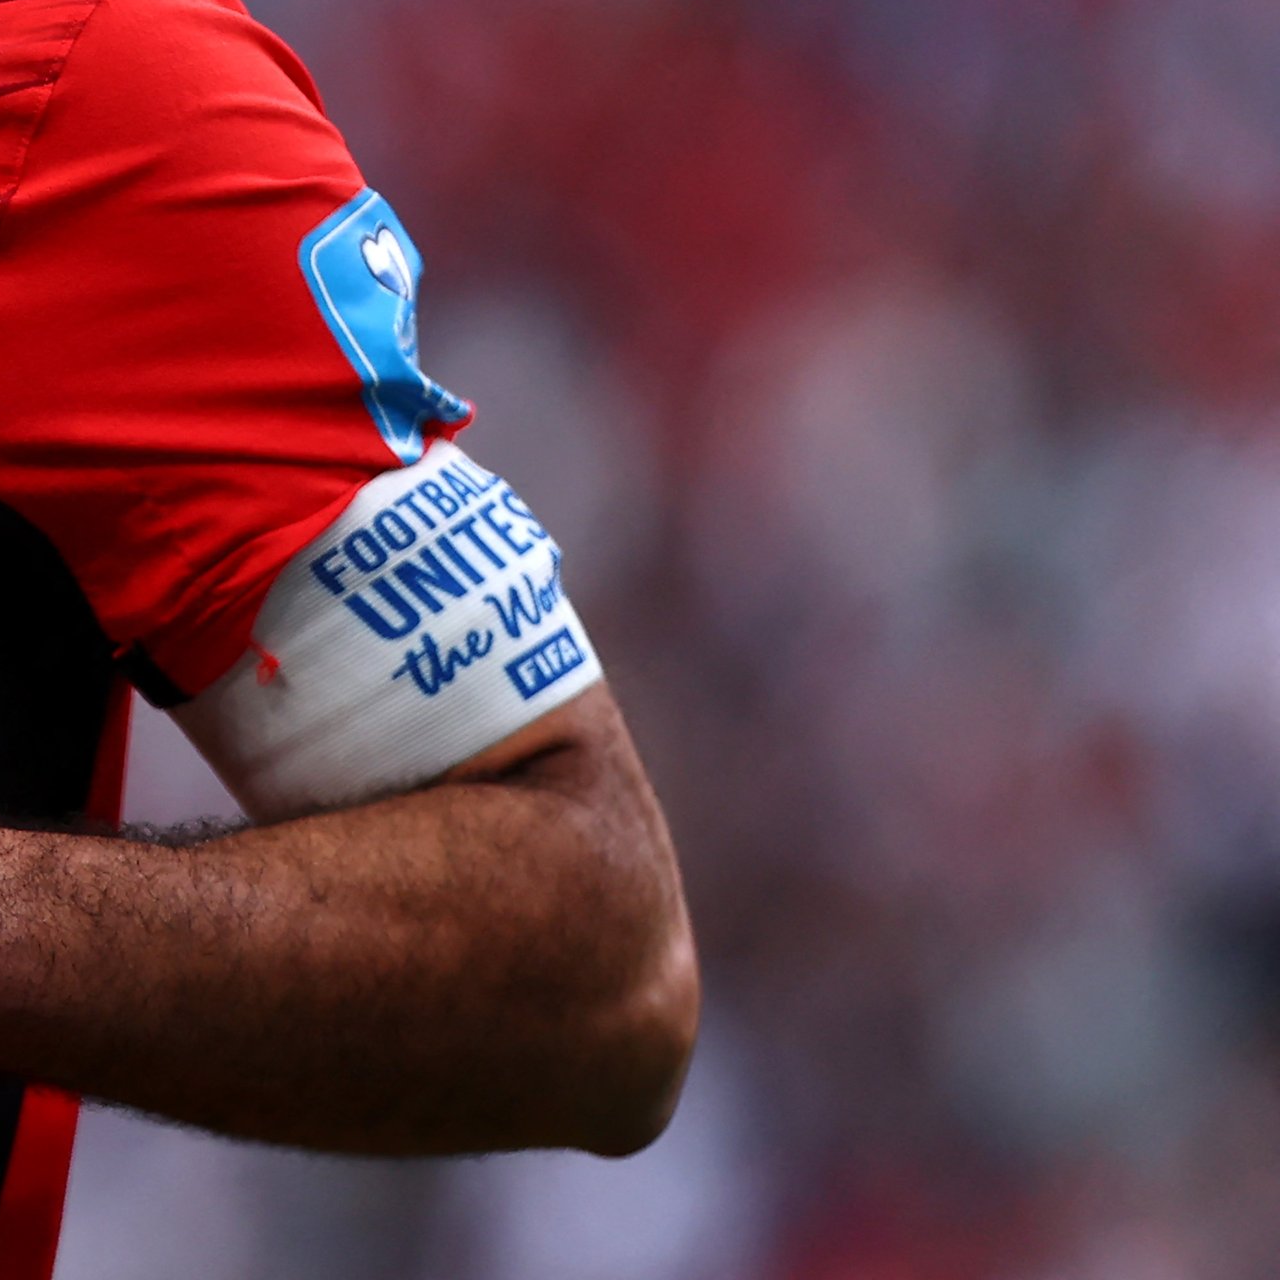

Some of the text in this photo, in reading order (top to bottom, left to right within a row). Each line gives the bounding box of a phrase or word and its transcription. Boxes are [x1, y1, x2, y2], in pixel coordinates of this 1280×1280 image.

[343, 488, 549, 641] UNITES
[392, 547, 559, 696] the Wor
[517, 635, 581, 690] FIFA
